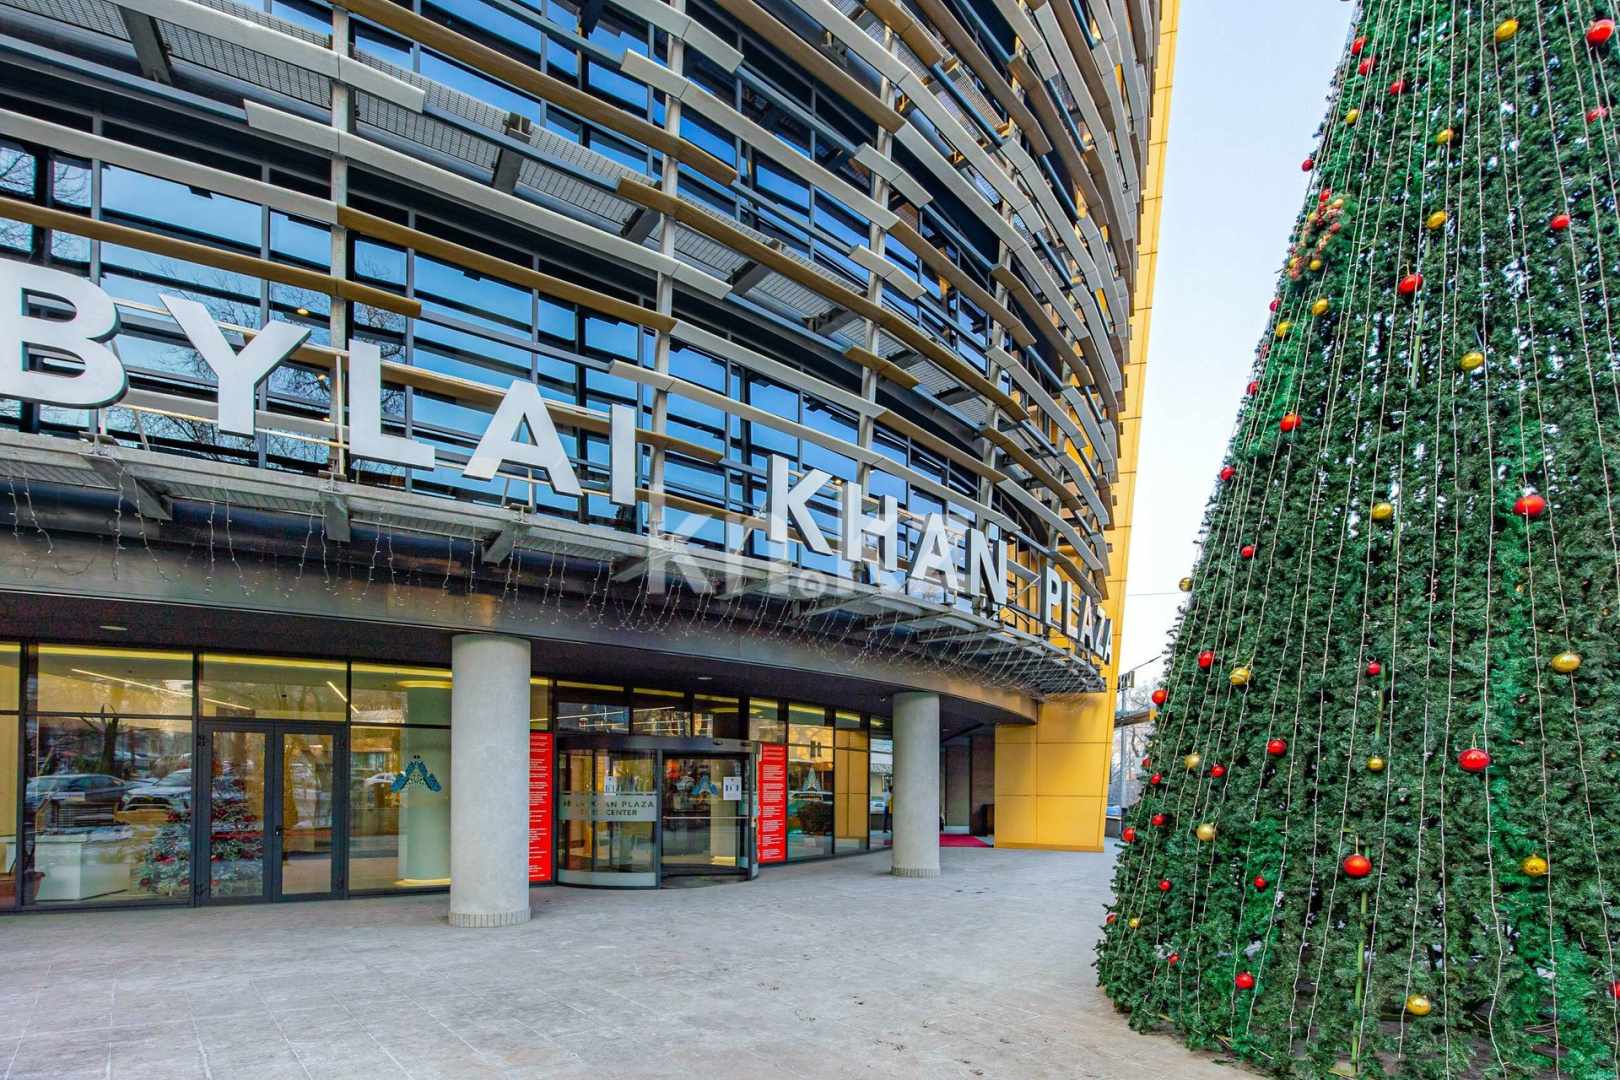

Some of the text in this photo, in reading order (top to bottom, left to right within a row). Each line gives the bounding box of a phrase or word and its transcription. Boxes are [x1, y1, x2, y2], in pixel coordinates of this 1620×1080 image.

[765, 453, 1008, 606] KHAN
[1041, 565, 1113, 666] PLAZA
[622, 800, 654, 808] PLAZA
